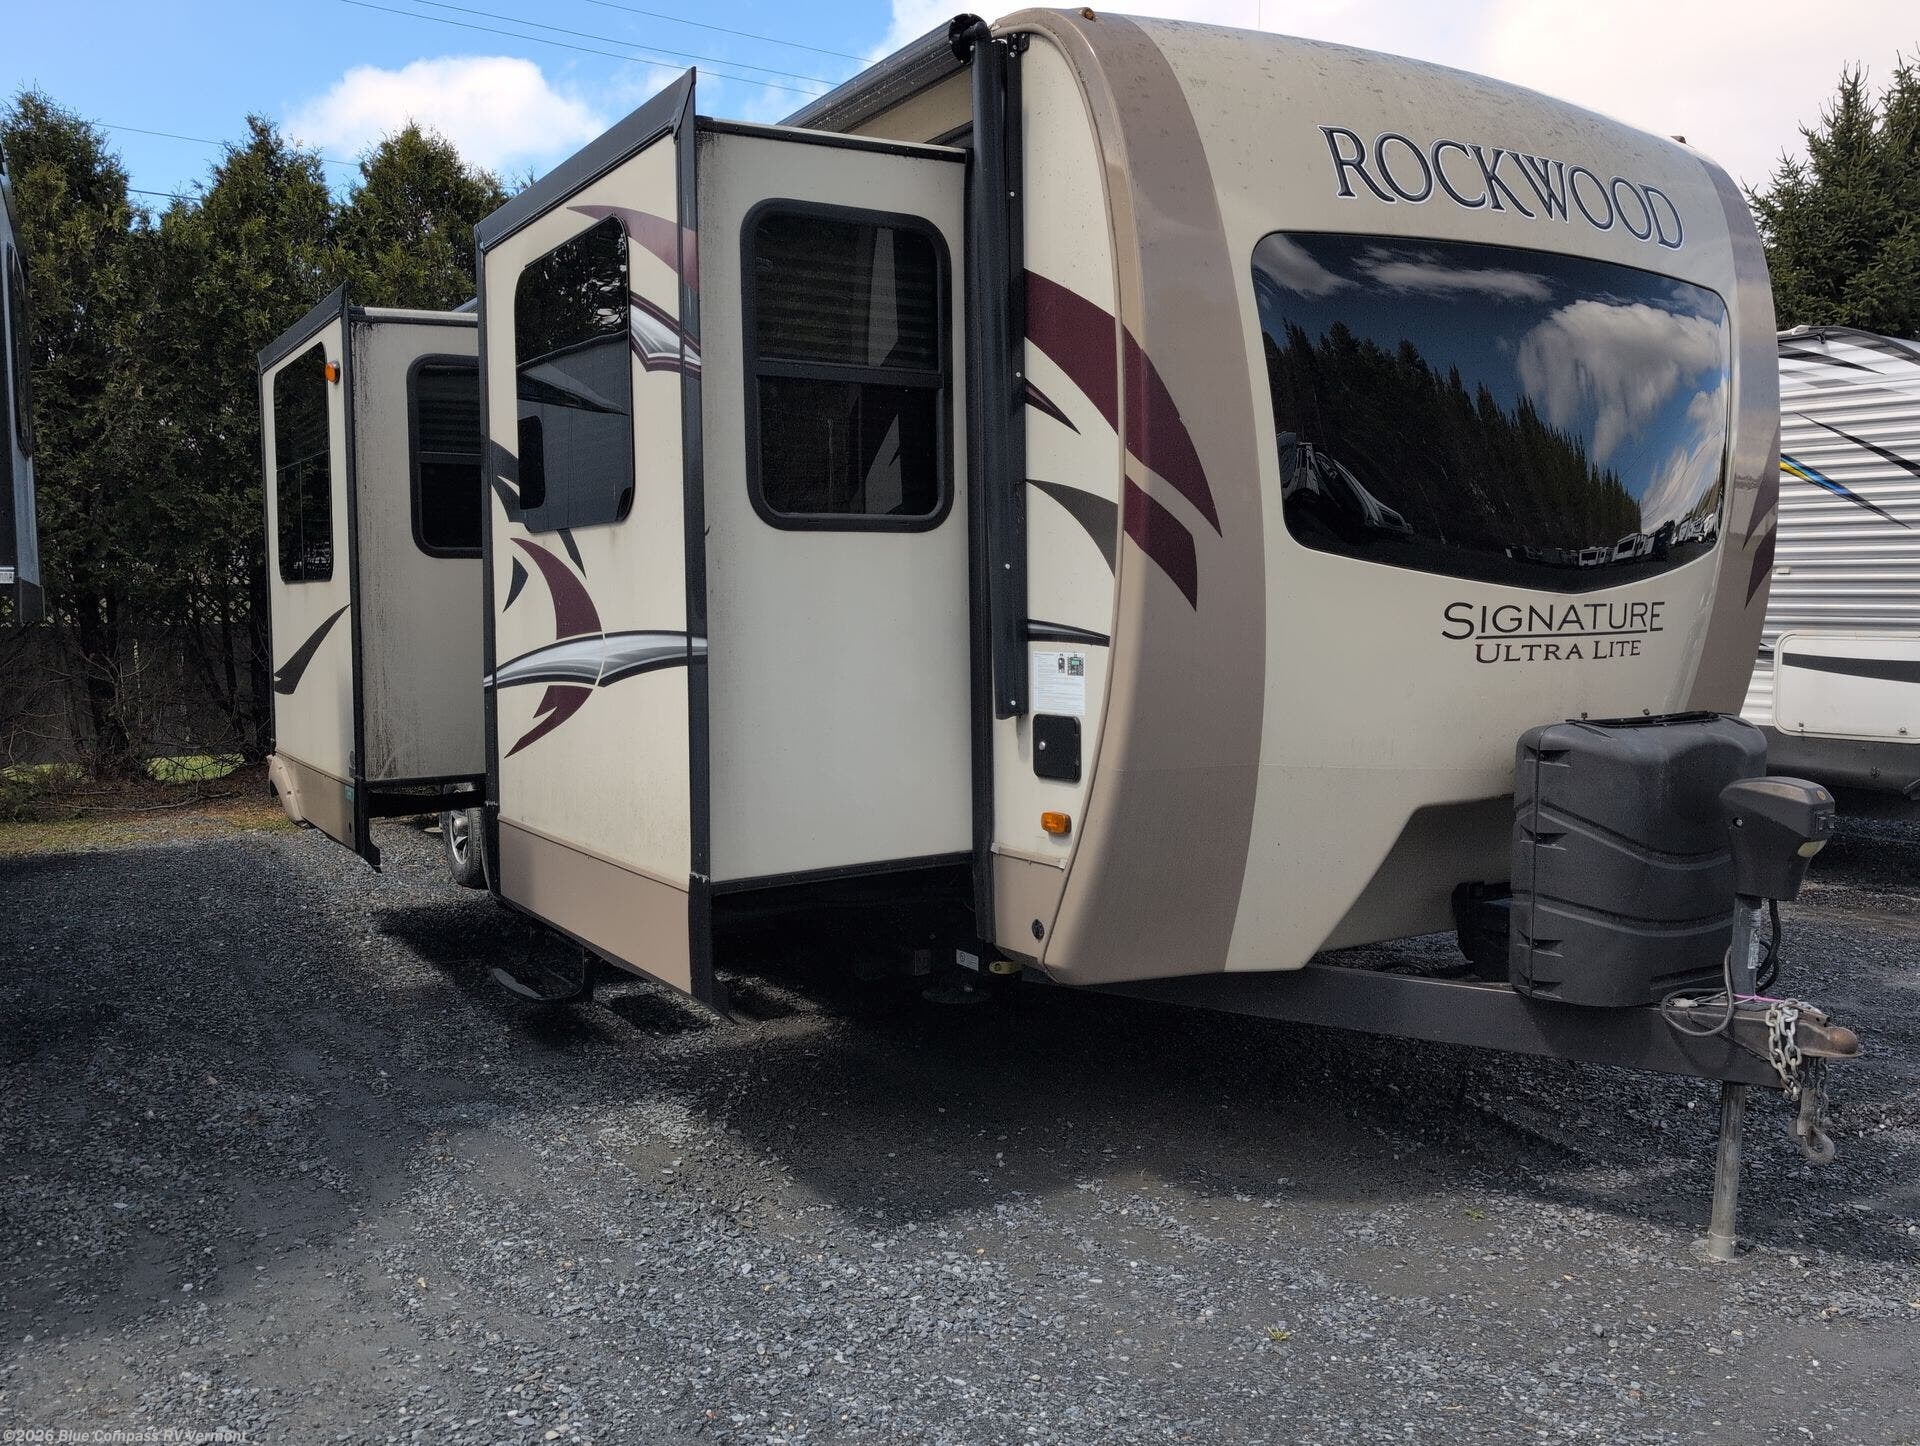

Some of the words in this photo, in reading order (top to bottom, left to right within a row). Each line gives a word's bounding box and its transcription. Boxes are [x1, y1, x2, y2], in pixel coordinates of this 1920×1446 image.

[1317, 124, 1684, 250] ROCKWOOD
[1441, 602, 1665, 640] SIGNATURE
[1475, 643, 1583, 663] ULTRA
[1593, 640, 1642, 660] LITE
